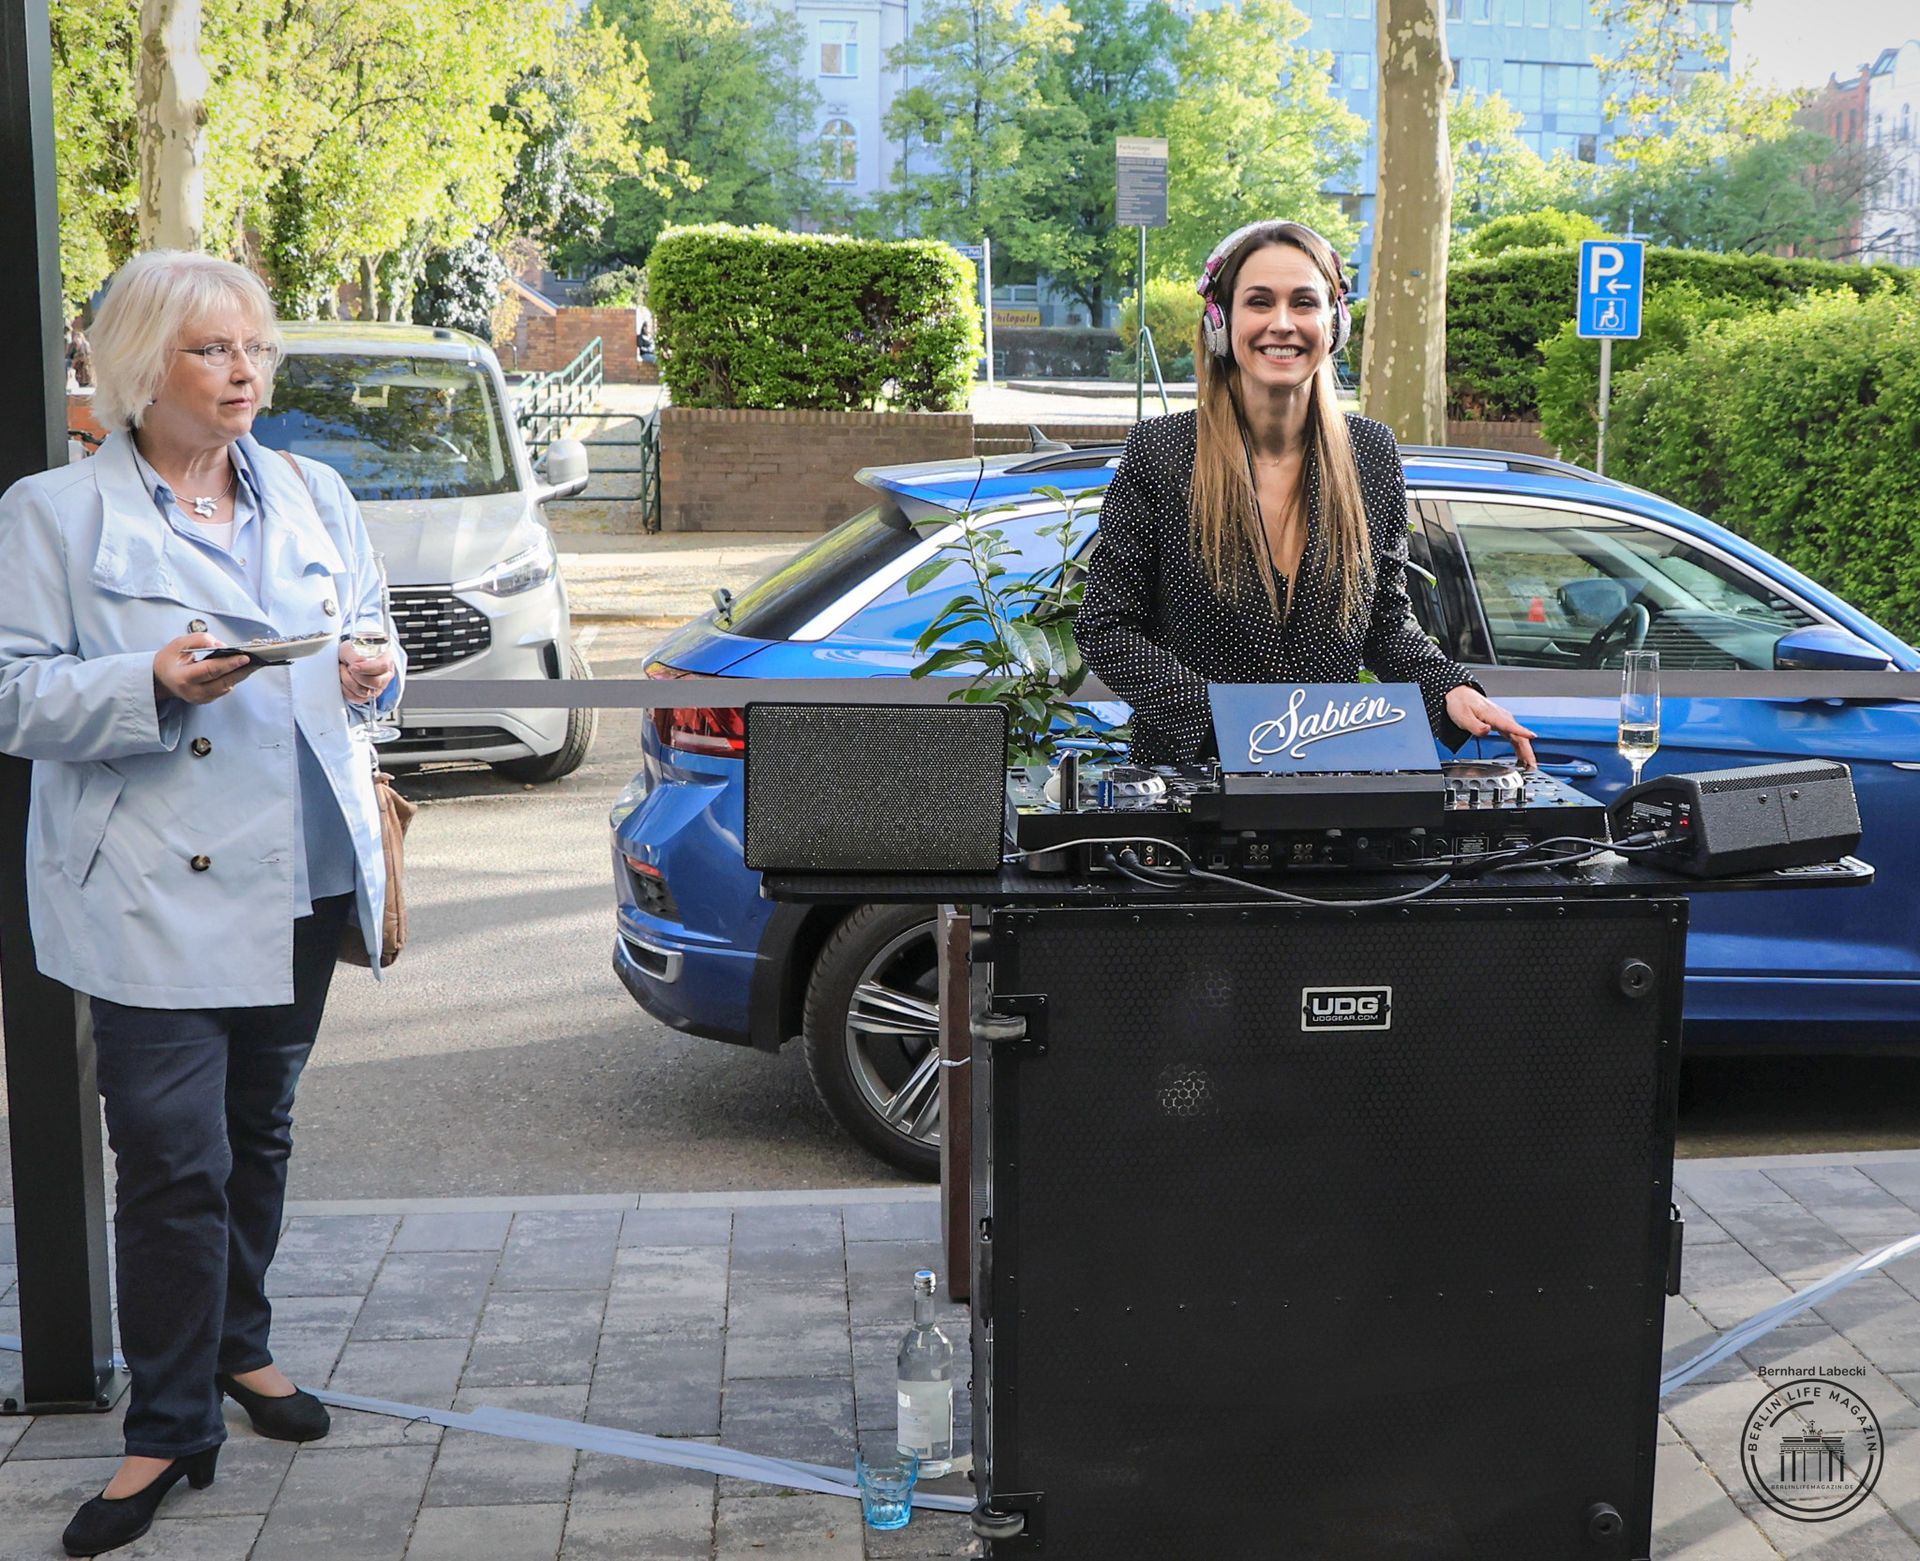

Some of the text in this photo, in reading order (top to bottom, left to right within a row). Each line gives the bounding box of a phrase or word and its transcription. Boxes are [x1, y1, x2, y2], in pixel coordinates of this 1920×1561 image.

[1589, 246, 1625, 294] P
[1248, 688, 1407, 764] Sabién
[1312, 996, 1379, 1016] UDG
[1312, 1014, 1379, 1022] UDGGEAR.COM
